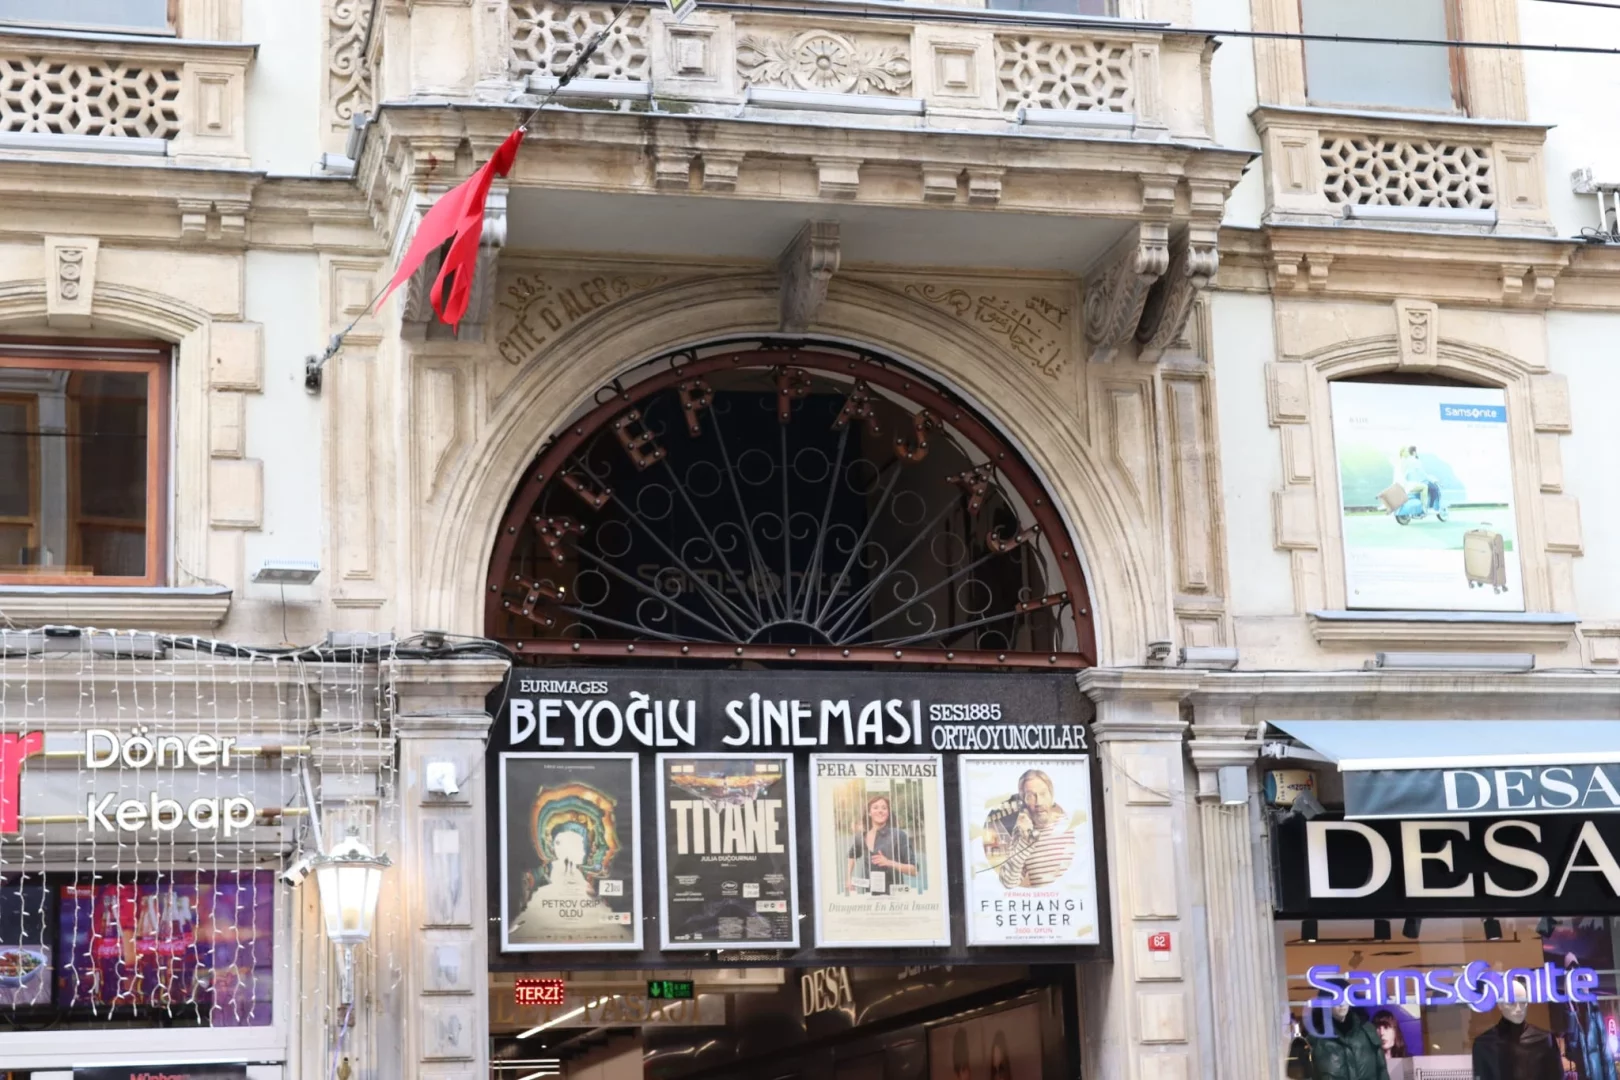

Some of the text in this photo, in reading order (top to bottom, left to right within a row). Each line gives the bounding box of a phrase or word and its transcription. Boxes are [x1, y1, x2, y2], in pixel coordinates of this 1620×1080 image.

[1445, 406, 1498, 419] Samsonite
[520, 680, 609, 694] EURIMAGES
[509, 690, 922, 747] BEYOĞLU SİNEMASI
[85, 727, 237, 769] Döner
[931, 724, 1088, 750] ORTAOYUNCULAR
[817, 763, 857, 777] PERA
[1443, 766, 1620, 811] DESA
[86, 791, 256, 837] Kebap
[670, 799, 785, 855] TITANE
[1306, 820, 1620, 899] DESA
[542, 899, 577, 909] PETROV
[558, 909, 584, 919] OLDU
[1153, 935, 1166, 947] 62
[517, 985, 560, 1001] TERZİ
[801, 966, 853, 1017] DESA
[1306, 959, 1599, 1013] Samsonite
